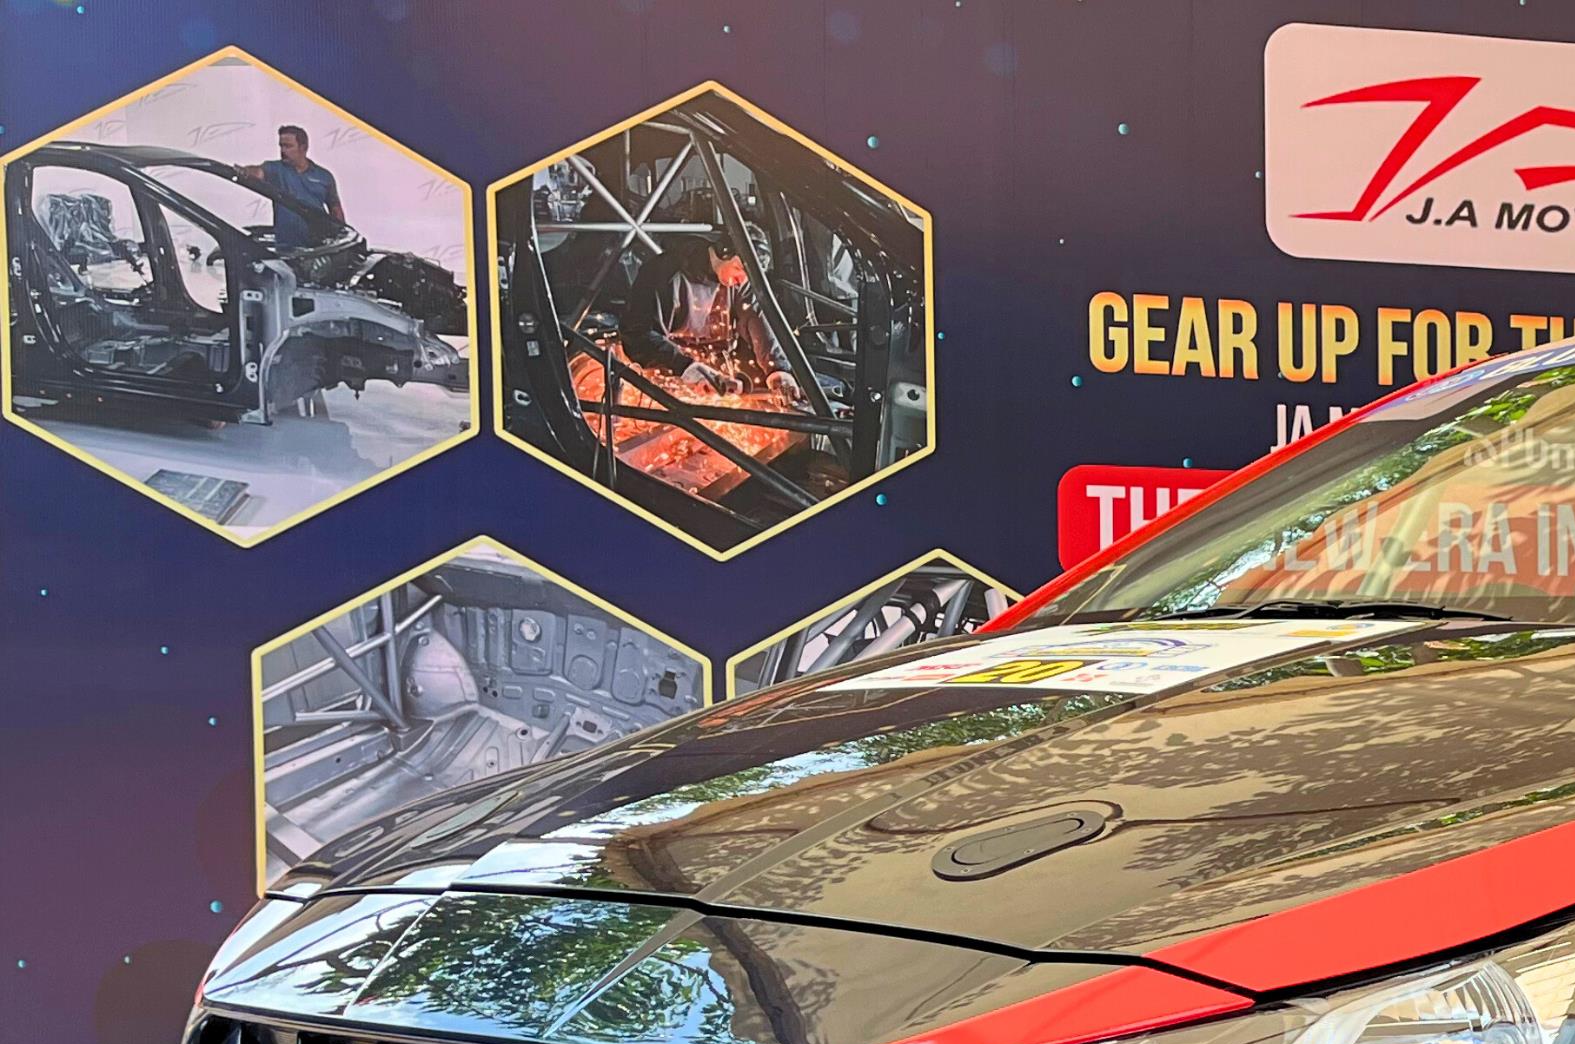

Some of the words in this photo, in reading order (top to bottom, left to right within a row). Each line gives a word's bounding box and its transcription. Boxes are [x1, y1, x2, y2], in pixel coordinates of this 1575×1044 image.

[1405, 198, 1478, 229] J.A
[1088, 291, 1259, 380] GEAR
[1278, 303, 1360, 384] UP
[1377, 307, 1494, 386] FOR
[951, 660, 1084, 683] 20
